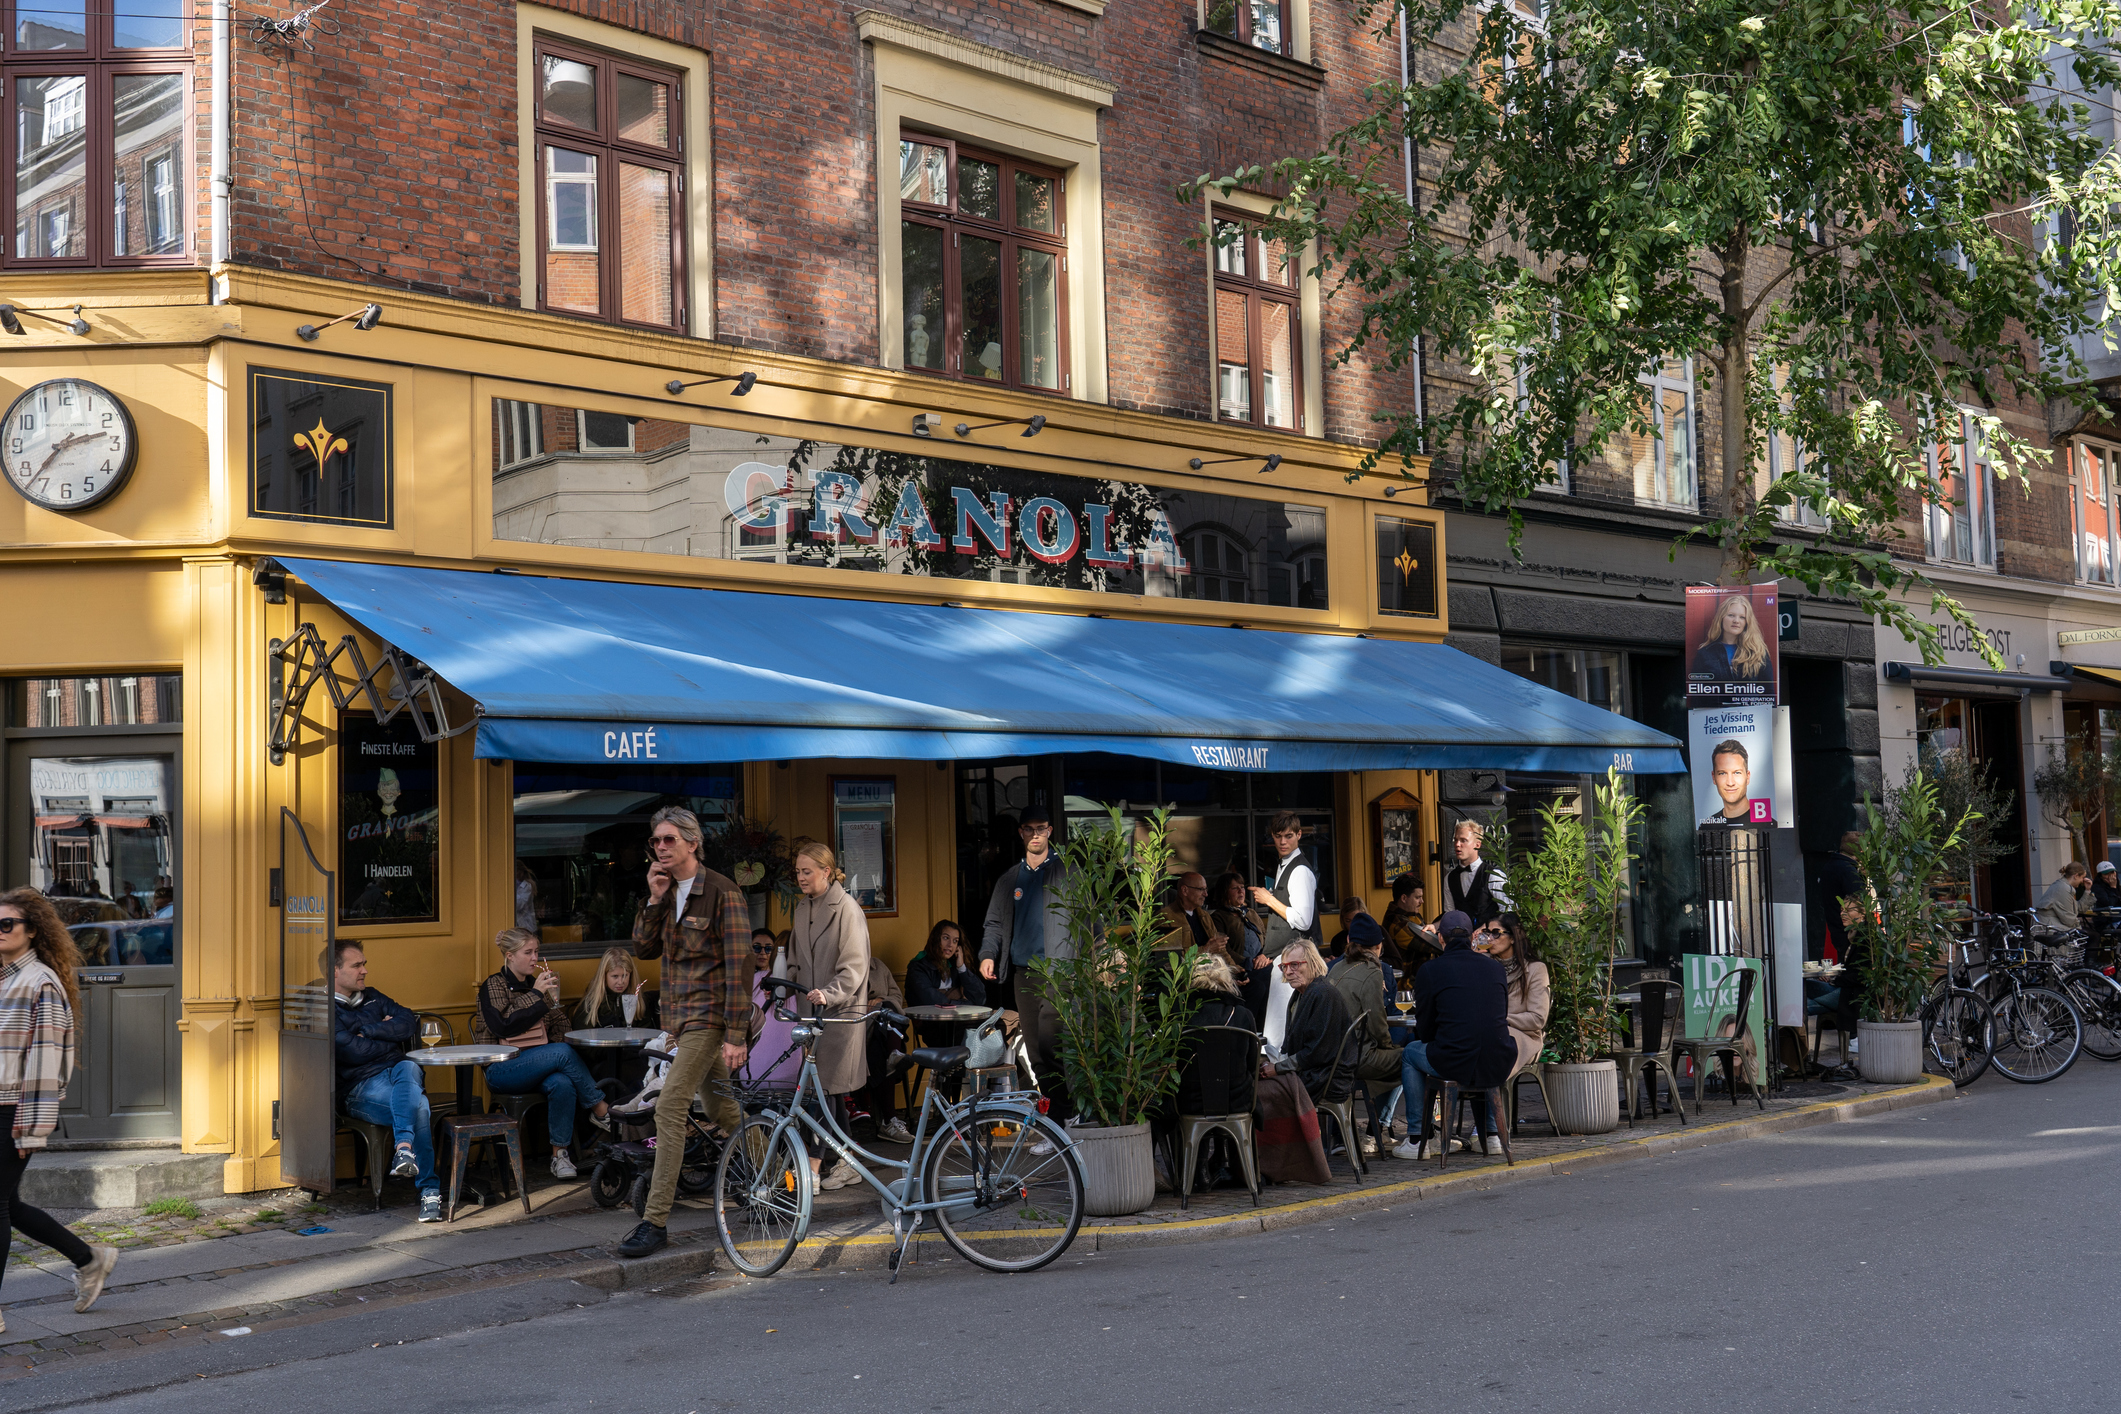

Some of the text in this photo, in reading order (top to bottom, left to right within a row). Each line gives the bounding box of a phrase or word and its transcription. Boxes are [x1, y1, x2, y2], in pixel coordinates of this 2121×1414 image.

[58, 390, 74, 406] 12
[20, 414, 34, 430] 10
[101, 412, 113, 428] 2
[12, 437, 23, 454] 9
[109, 435, 121, 452] 3
[20, 460, 32, 477] 8
[100, 459, 113, 475] 4
[38, 477, 50, 493] 7
[60, 483, 72, 499] 6
[83, 476, 94, 492] 5
[724, 461, 1190, 574] GRANOLA
[1986, 628, 2011, 656] OST
[2060, 633, 2082, 643] DAL
[1688, 683, 1765, 694] Ellen Emilie
[1705, 712, 1754, 726] Jes Vissing
[1704, 724, 1755, 735] Tiedemann
[361, 741, 415, 755] FINESTE KAFFE
[604, 726, 658, 758] CAFÉ
[1191, 745, 1269, 768] RESTAURANT
[1613, 753, 1633, 771] BAR
[848, 786, 880, 800] MENU
[1754, 802, 1767, 819] B
[347, 811, 429, 841] GRANOLA
[850, 823, 875, 831] GRANOLA
[1700, 816, 1727, 825] radikale
[371, 864, 412, 877] HANDELEN
[1387, 863, 1412, 878] RICARD
[287, 896, 325, 914] GRANOLA
[289, 926, 313, 934] RESTAURANT
[1692, 955, 1754, 990] IDA
